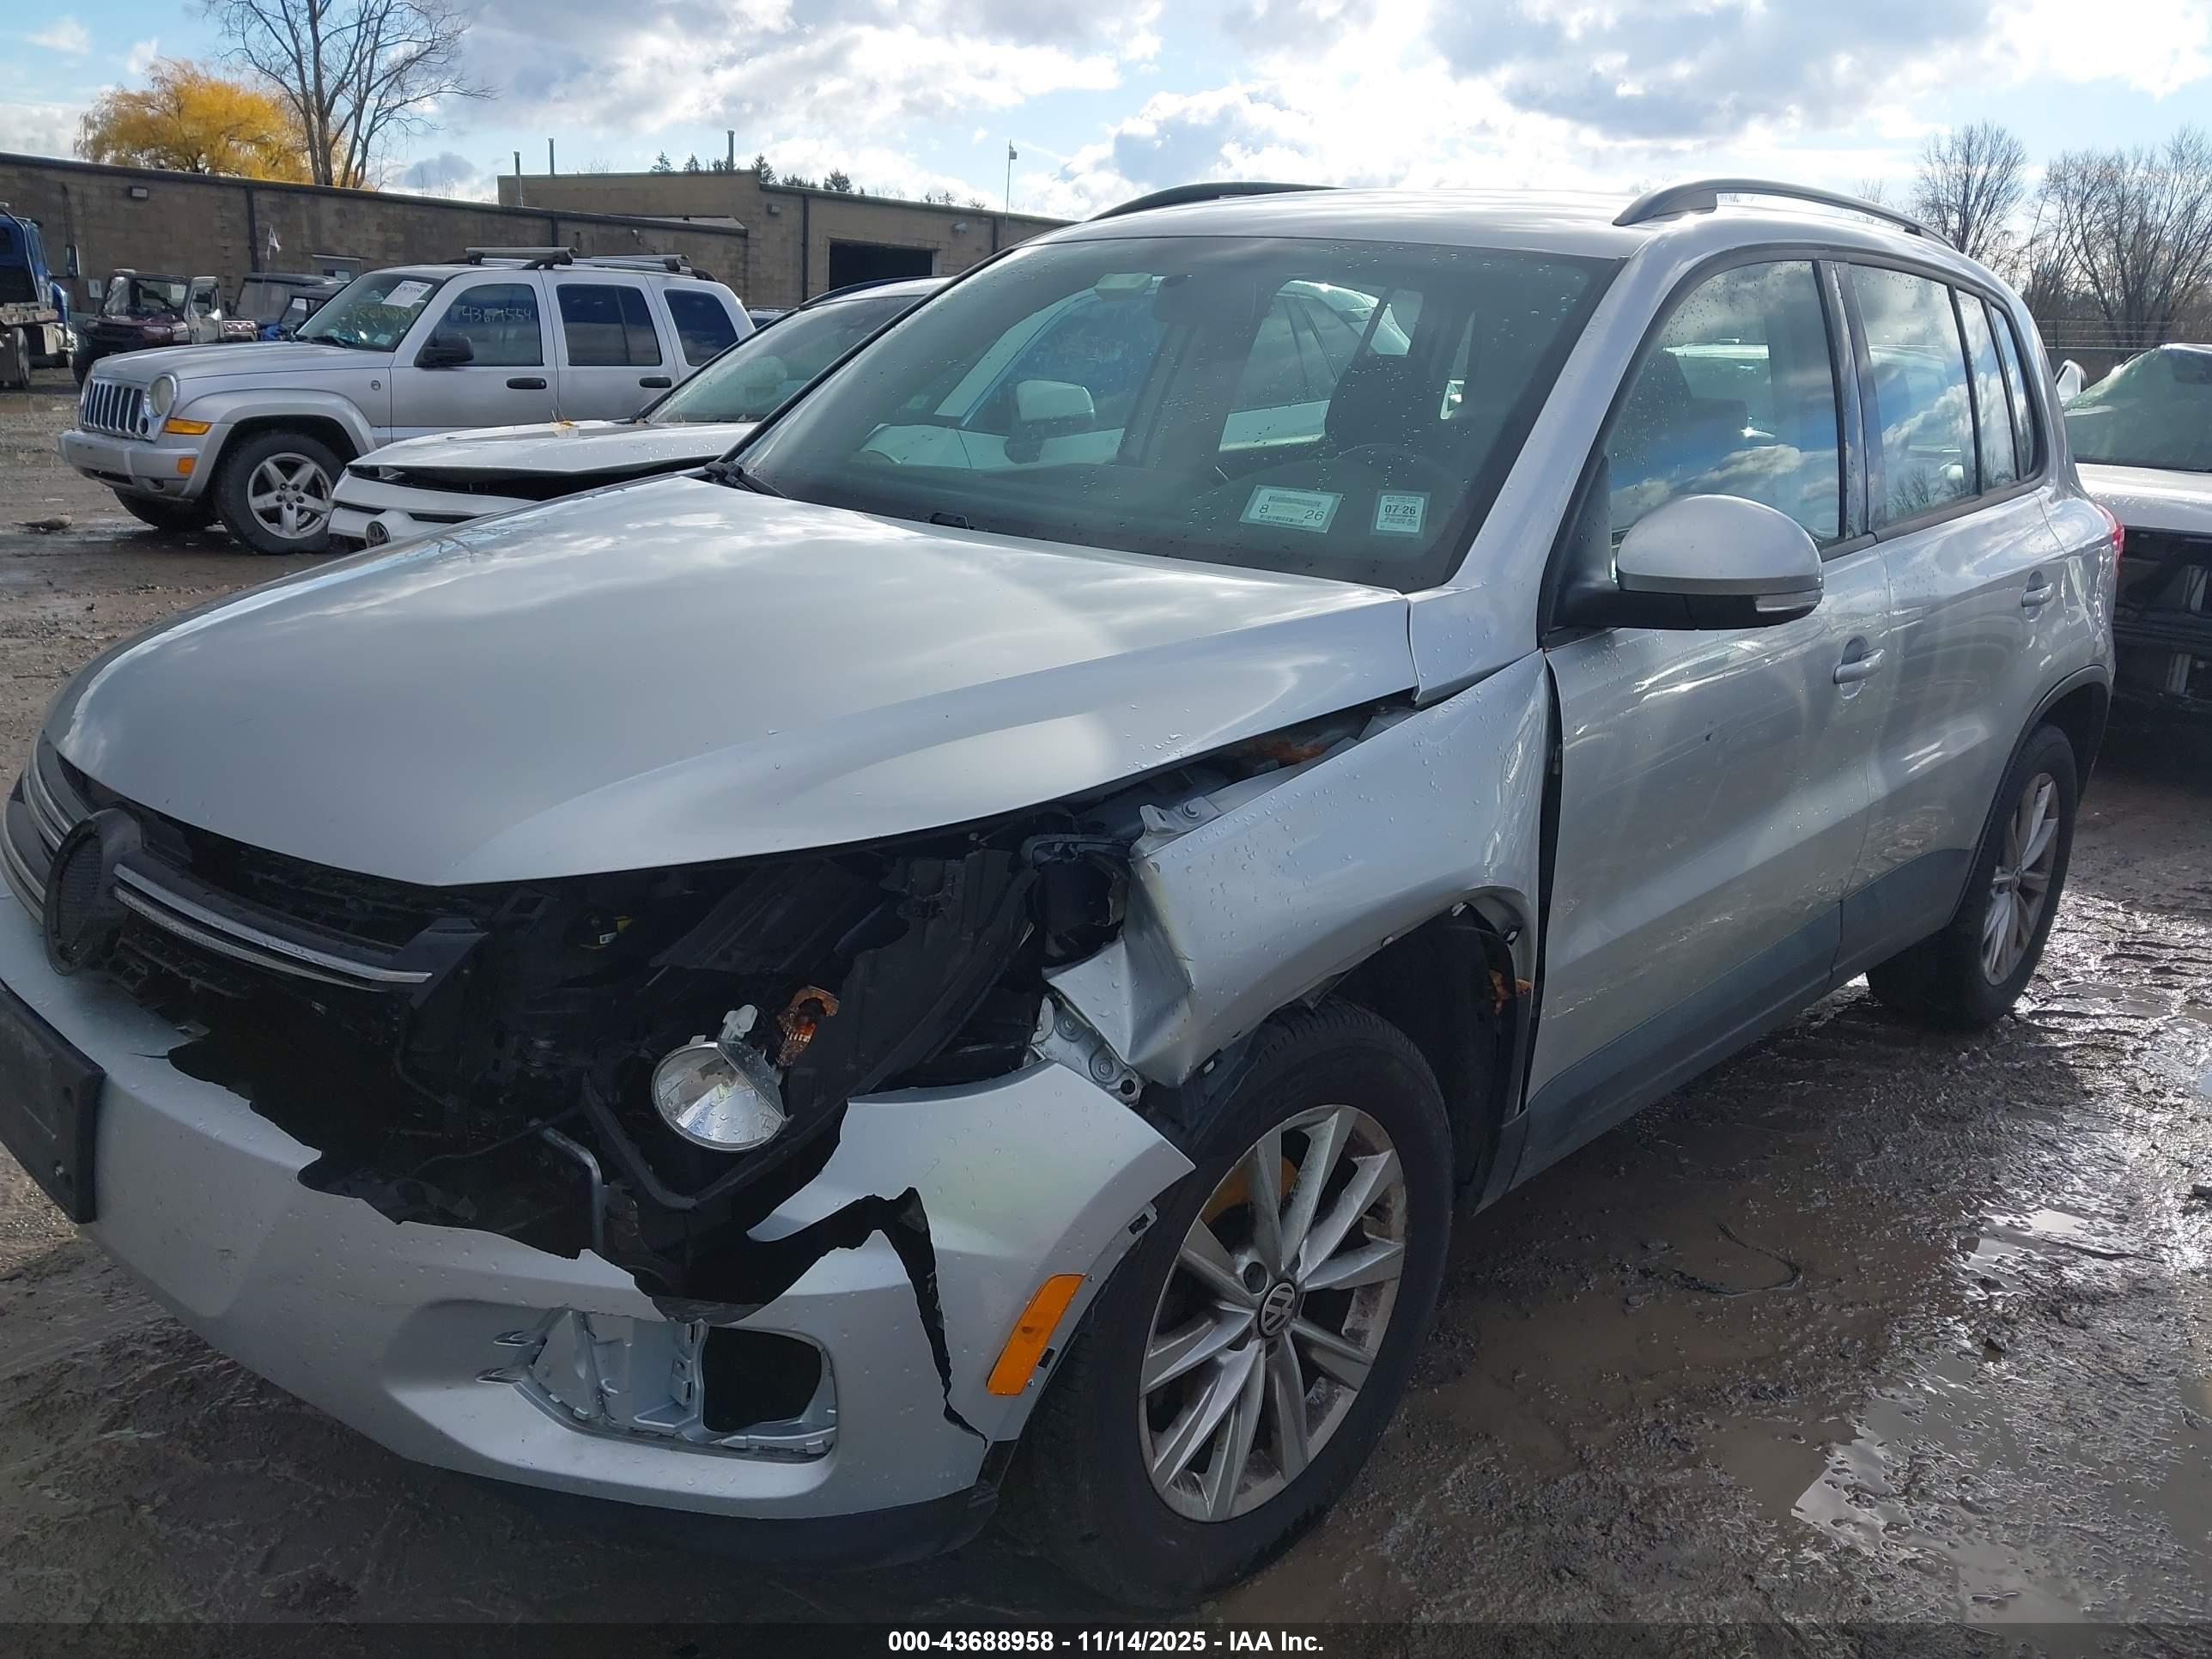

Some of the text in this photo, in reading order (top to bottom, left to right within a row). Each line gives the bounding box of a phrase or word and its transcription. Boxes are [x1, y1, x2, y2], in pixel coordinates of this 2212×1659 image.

[1259, 504, 1269, 514] 8
[1304, 510, 1325, 521] 26
[1261, 1283, 1295, 1336] VW
